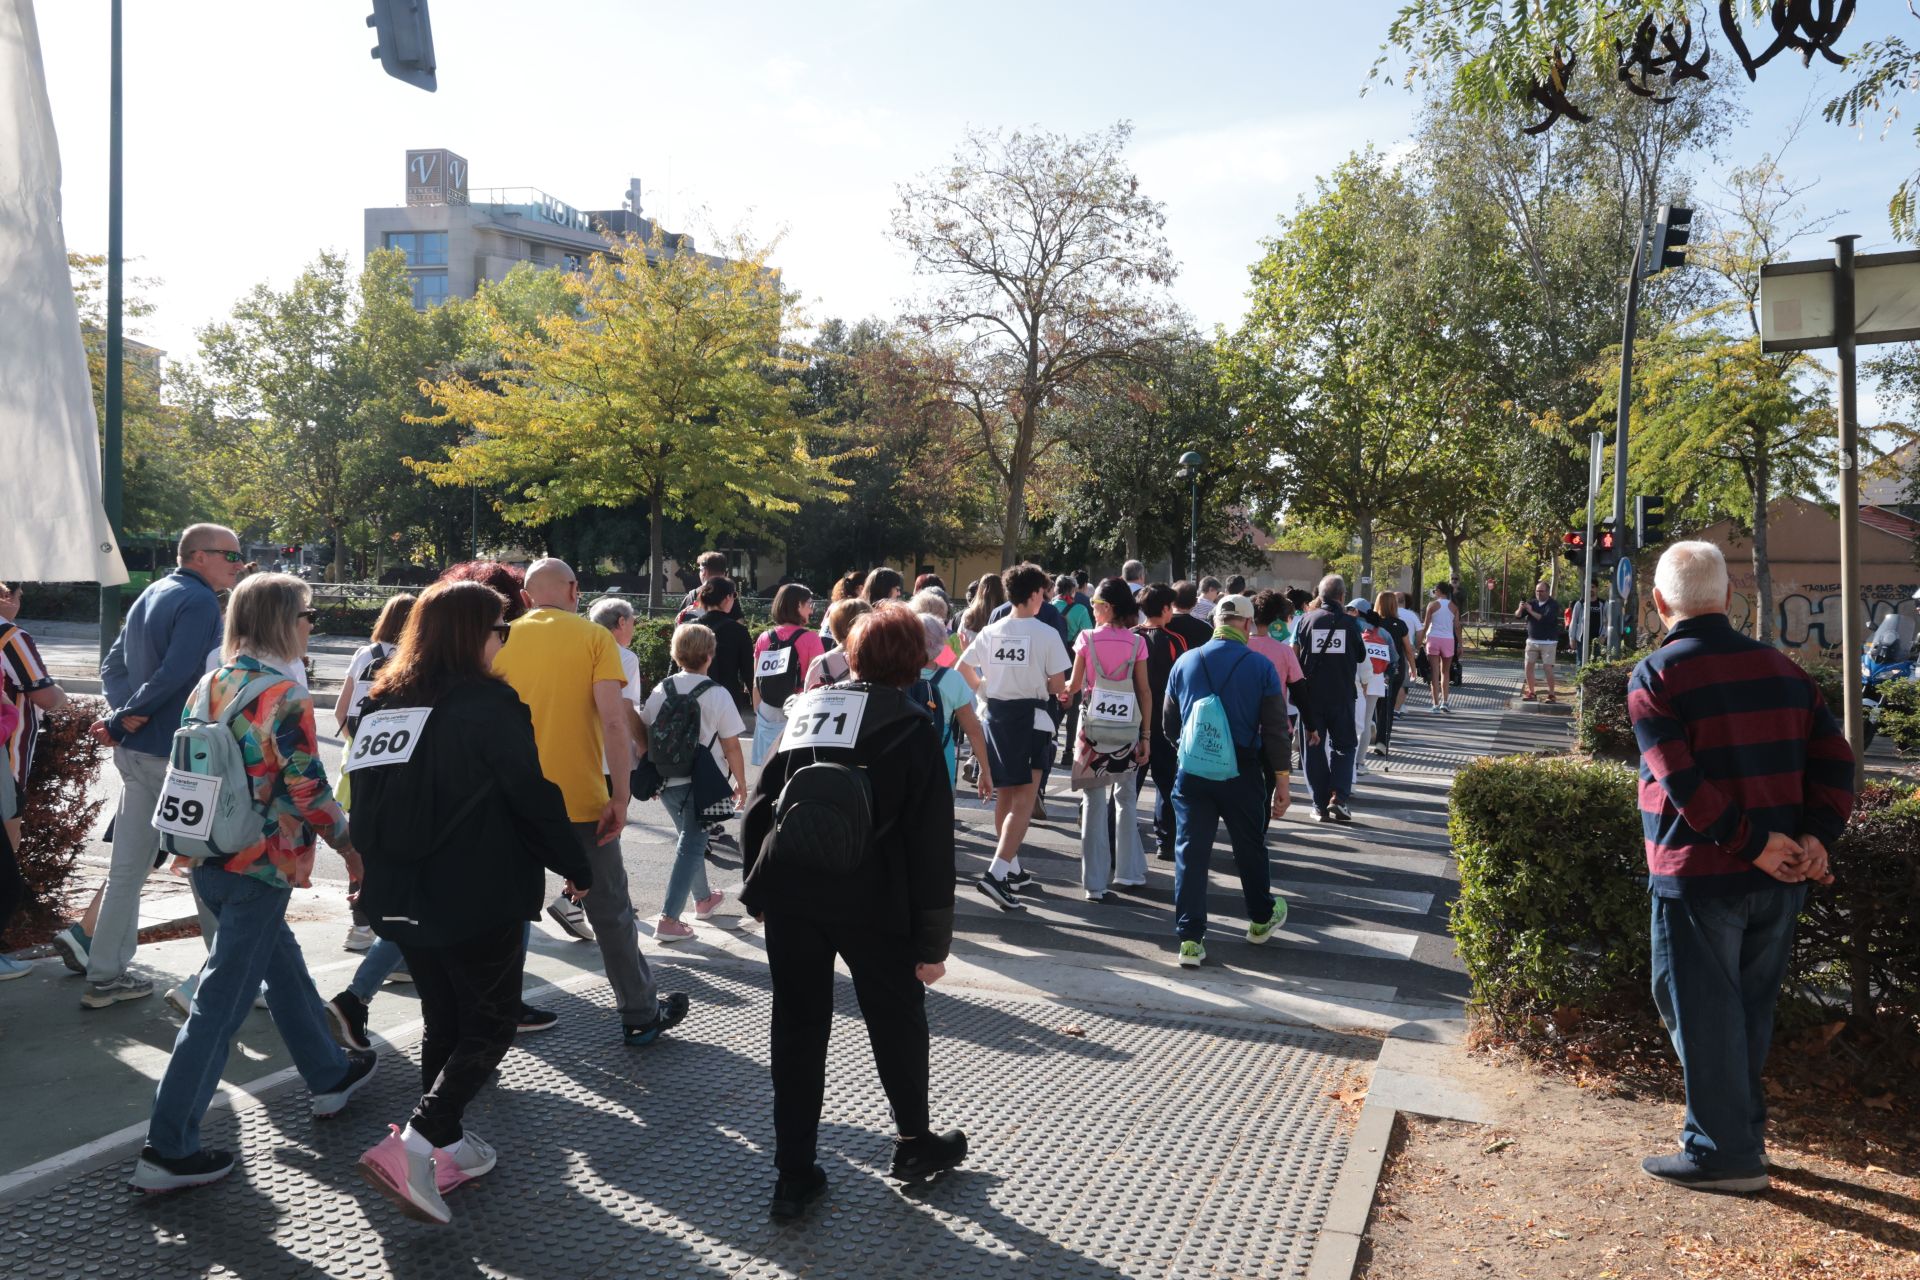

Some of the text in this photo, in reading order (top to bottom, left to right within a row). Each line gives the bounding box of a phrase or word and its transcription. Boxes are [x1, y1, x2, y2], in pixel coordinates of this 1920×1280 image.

[411, 154, 436, 184] V
[994, 648, 1025, 661] 443
[1367, 647, 1388, 657] 025
[761, 657, 785, 671] 002
[1096, 701, 1128, 716] 442
[791, 711, 847, 738] 571
[354, 730, 410, 760] 360
[157, 794, 204, 826] 59
